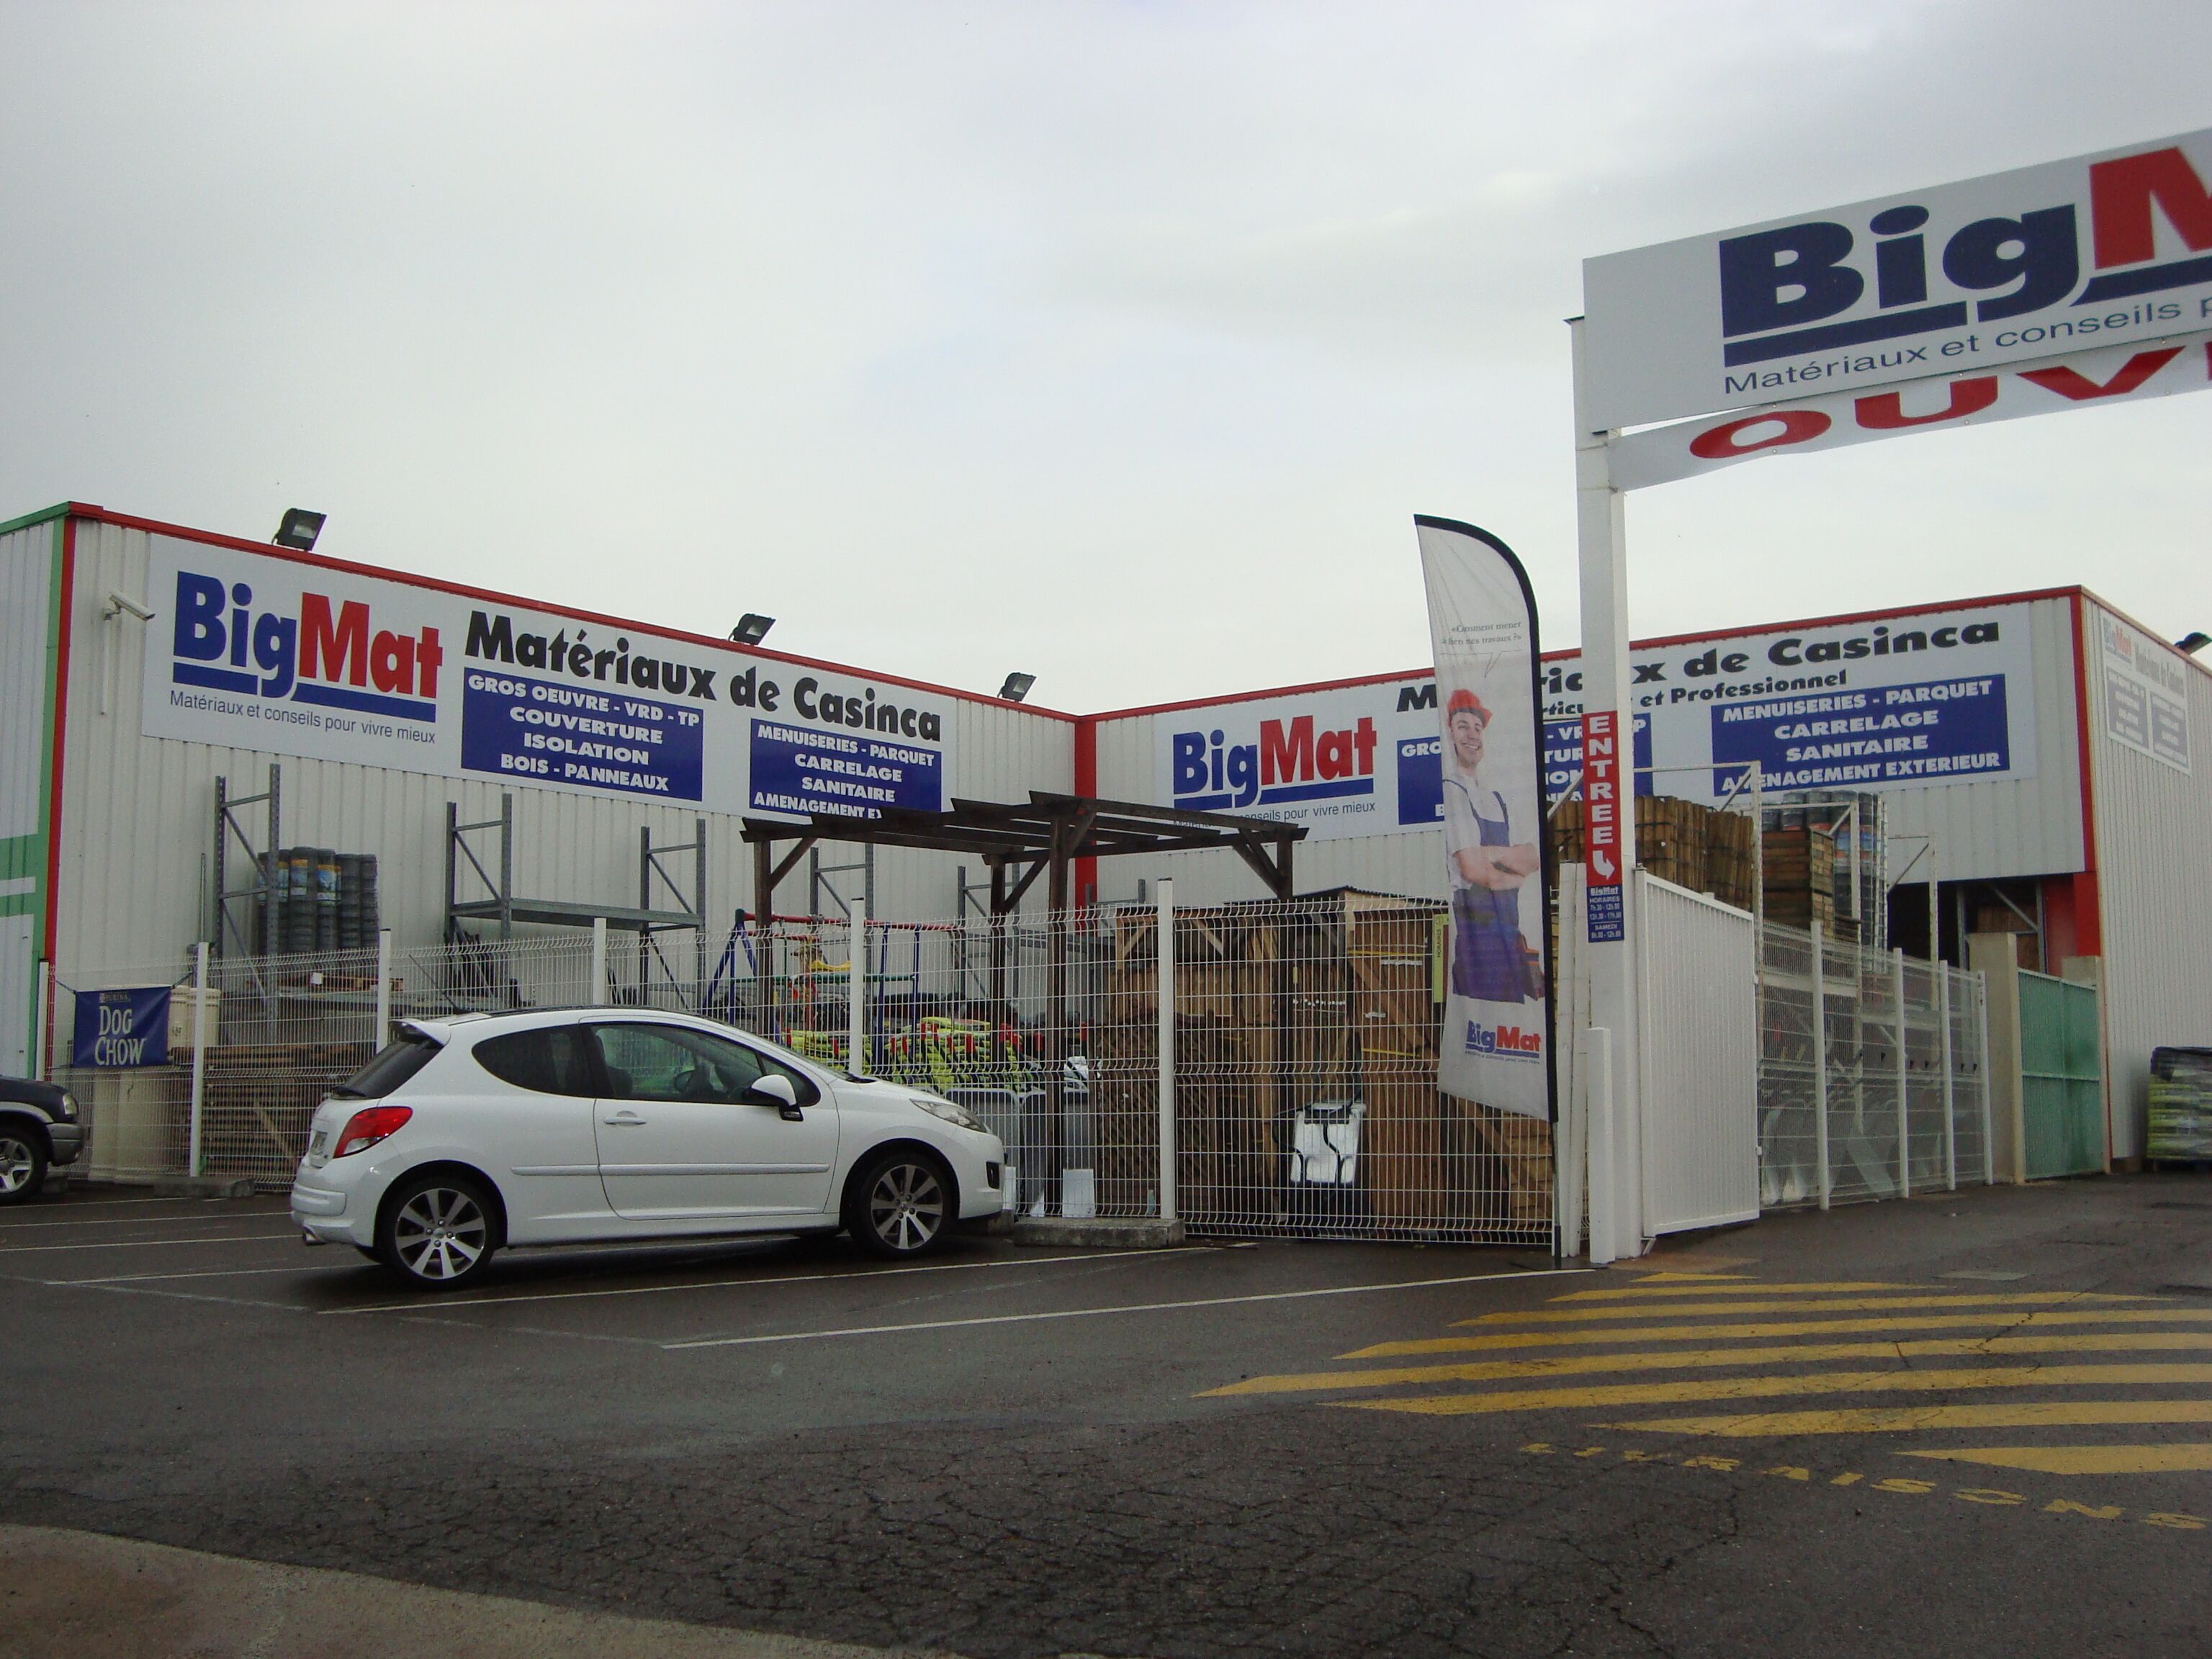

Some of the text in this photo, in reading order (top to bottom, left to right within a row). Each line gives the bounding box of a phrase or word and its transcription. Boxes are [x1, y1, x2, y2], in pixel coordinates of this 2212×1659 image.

[1725, 346, 1928, 394] Matériaux
[1941, 333, 1979, 356] et
[1995, 303, 2181, 348] conseils
[1689, 341, 2212, 459] OUV
[173, 570, 443, 697] BigMat
[1684, 648, 1750, 678] de
[1768, 621, 2000, 667] Casinca
[465, 611, 940, 742] Matériaux de Casinca
[1640, 691, 1665, 708] et
[1671, 669, 1847, 703] Professionnel
[170, 690, 436, 743] Matériaux et conseils pour vivre mieux
[469, 675, 526, 698] GROS
[532, 685, 610, 712] OEUVRE
[624, 702, 663, 721] VRD
[678, 711, 699, 727] TP
[1723, 694, 1866, 723] MENUISERIES
[1886, 680, 1992, 705] PARQUET
[510, 706, 662, 744] COUVERTURE
[1401, 741, 1442, 757] GRO
[1557, 726, 1583, 740] VR
[1774, 710, 1939, 739] CARRELAGE
[523, 732, 649, 765] ISOLATION
[758, 724, 858, 753] MENUISERIES
[870, 745, 935, 766] PARQUET
[1174, 715, 1377, 806] BigMat
[1786, 734, 1929, 763] SANITAIRE
[1886, 752, 2001, 776] EXTERIEUR
[501, 754, 549, 773] BOIS
[565, 763, 668, 791] PANNEAUX
[795, 754, 902, 782] CARRELAGE
[1588, 715, 1614, 845] ENTREE
[755, 792, 865, 819] AMENAGEMENT
[802, 777, 895, 802] SANITAIRE
[1284, 809, 1308, 823] pour
[1313, 804, 1339, 817] vivre
[1342, 801, 1376, 814] mieux
[99, 1006, 132, 1035] DOG
[1465, 1020, 1541, 1053] BigMat
[94, 1036, 147, 1065] CHOW
[1519, 1442, 2211, 1529] LIVRAISONS
